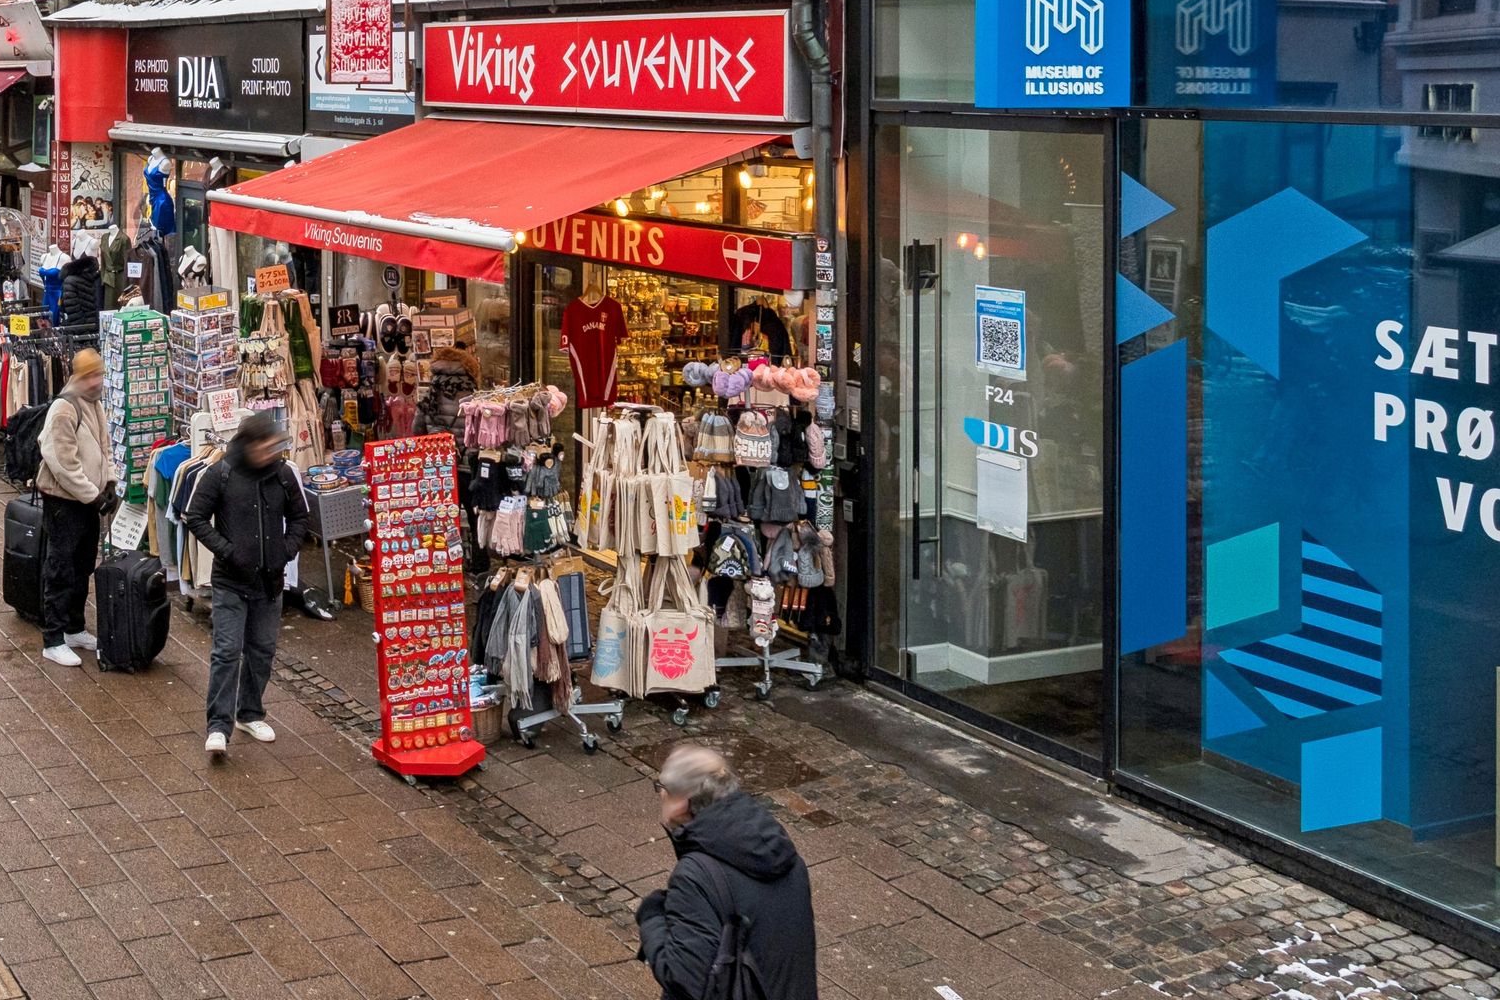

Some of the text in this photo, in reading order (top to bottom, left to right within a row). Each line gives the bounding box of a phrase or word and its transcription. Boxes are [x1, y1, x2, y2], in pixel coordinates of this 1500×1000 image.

[134, 59, 168, 74] PAS PHOTO
[252, 58, 280, 74] STUDIO
[448, 26, 756, 104] Viking SOUVENIRS
[1025, 65, 1104, 79] MUSEUM OF
[134, 78, 168, 93] 2 MINUTER
[178, 56, 220, 99] DIJA
[241, 80, 291, 96] PRINT-PHOTO
[1025, 80, 1104, 95] ILLUSIONS
[178, 98, 192, 108] Dress
[192, 98, 202, 108] like
[207, 100, 220, 110] diva
[59, 206, 70, 239] BAR
[304, 222, 382, 252] Viking Souvenirs
[1374, 319, 1498, 385] SÆT
[985, 385, 1014, 406] F24
[1374, 391, 1496, 462] PRØ
[980, 420, 1039, 458] DIS
